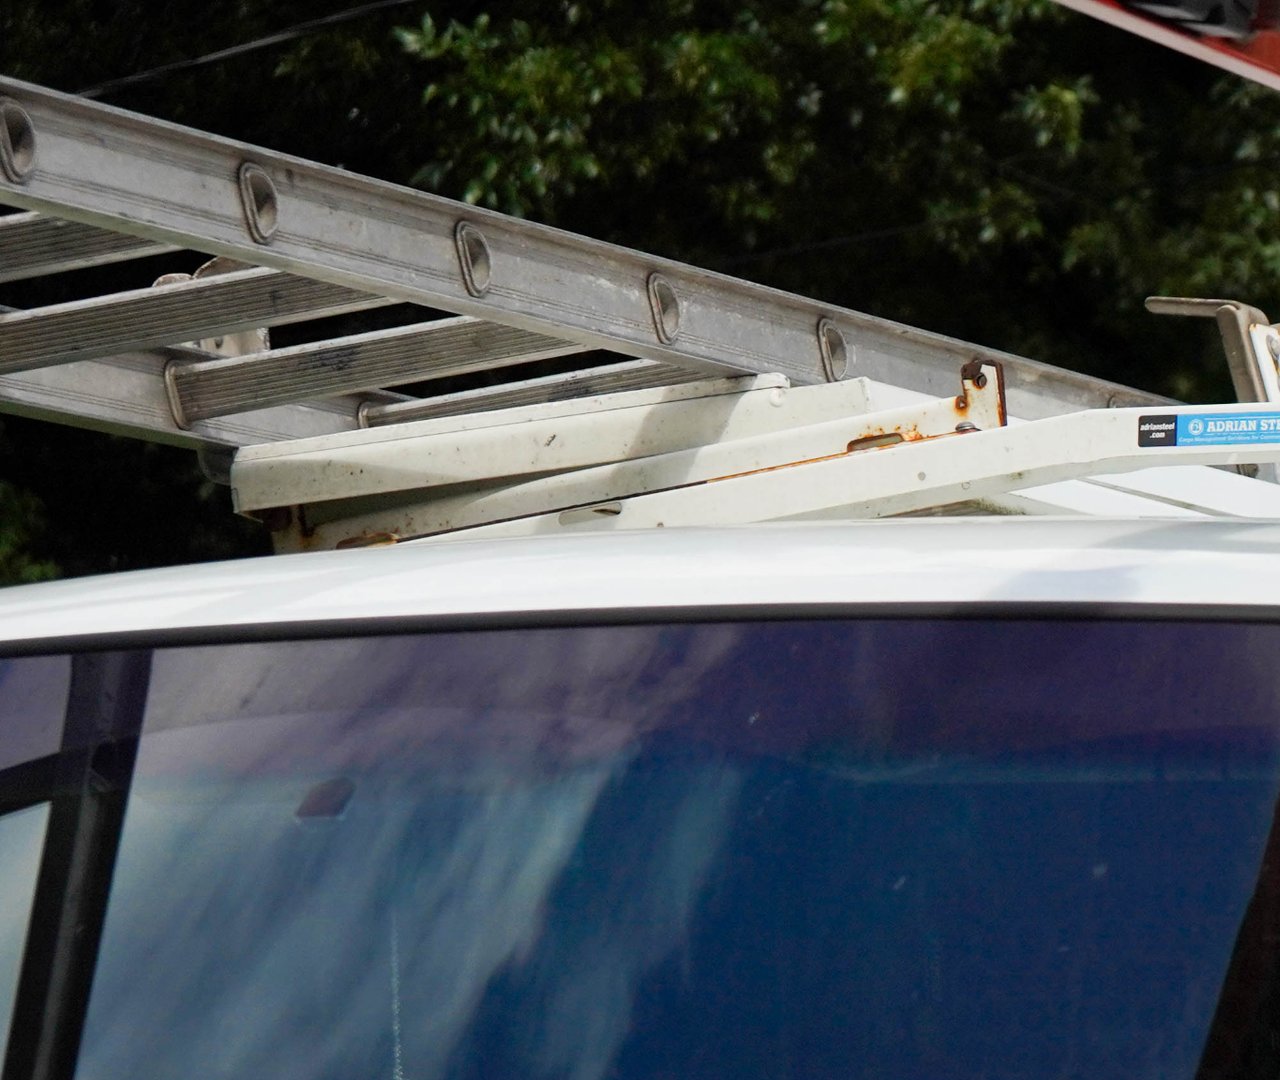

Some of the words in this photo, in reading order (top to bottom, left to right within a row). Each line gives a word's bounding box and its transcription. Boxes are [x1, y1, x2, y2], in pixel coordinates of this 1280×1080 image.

[1140, 422, 1175, 431] adriansteel
[1207, 420, 1257, 432] ADRIAN
[1149, 431, 1166, 439] .com
